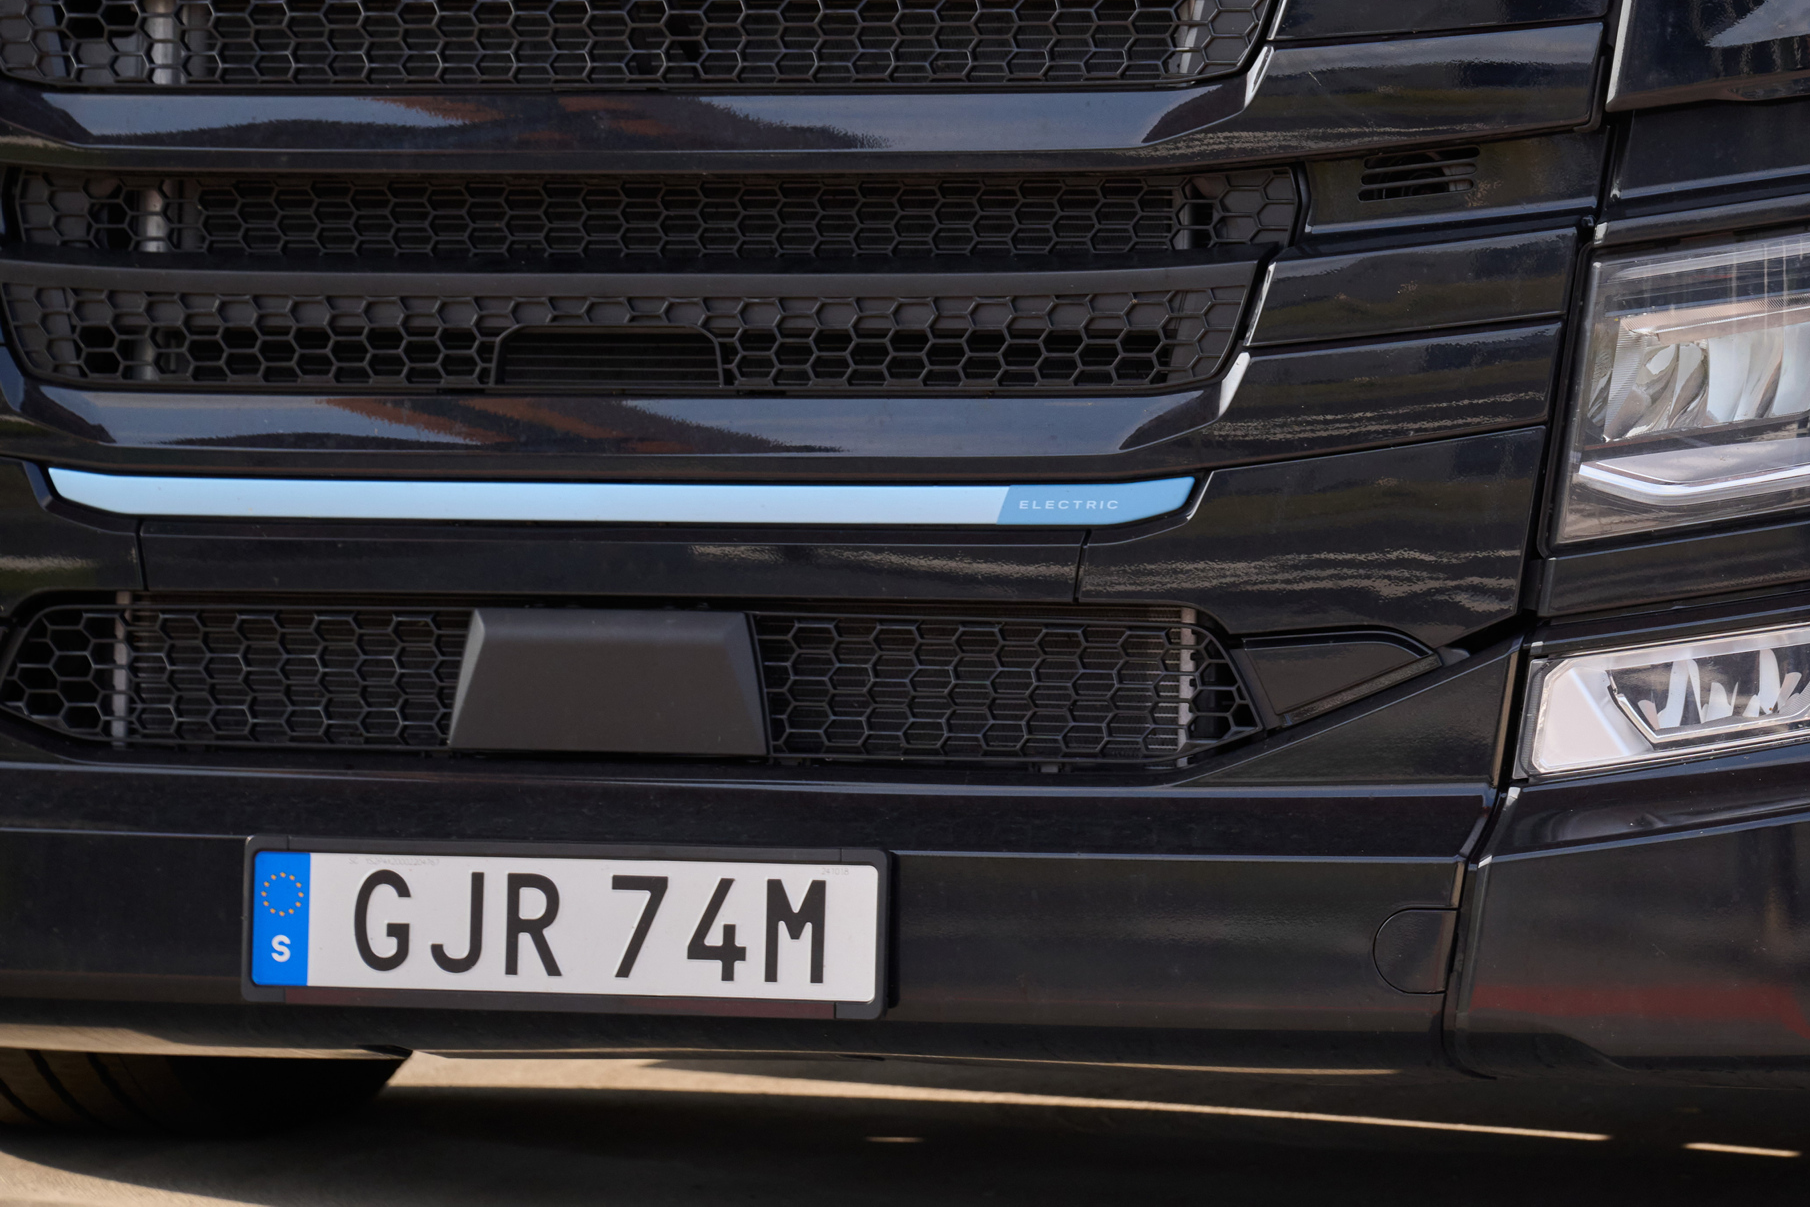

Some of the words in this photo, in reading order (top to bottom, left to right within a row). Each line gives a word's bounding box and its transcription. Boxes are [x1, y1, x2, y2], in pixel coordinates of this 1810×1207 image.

[1019, 500, 1119, 510] ELECTRIC
[354, 869, 563, 977] GJR
[611, 874, 828, 984] 74M
[270, 934, 291, 963] S
